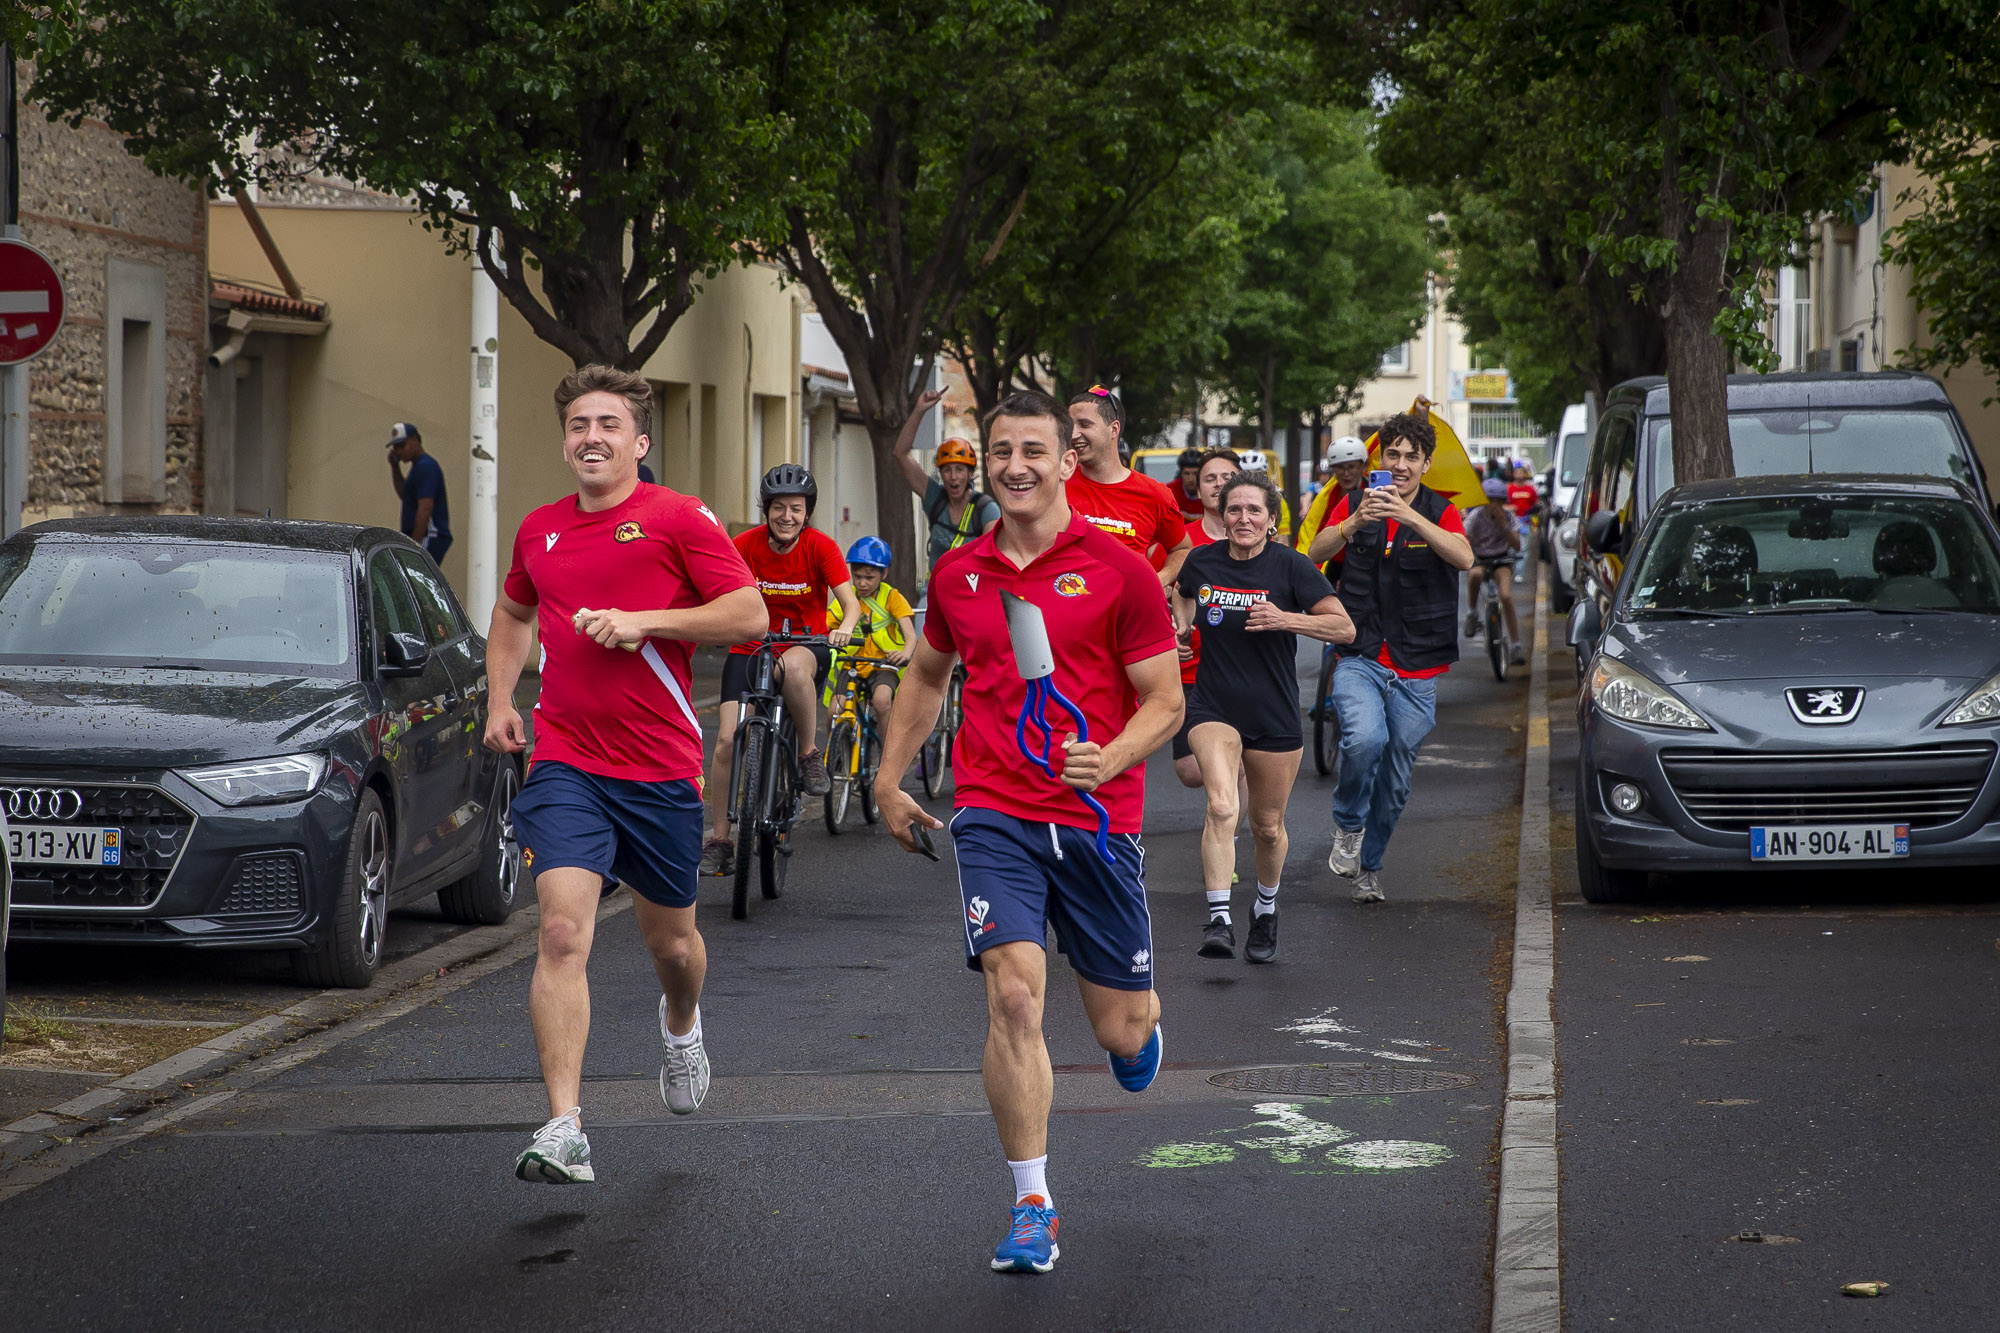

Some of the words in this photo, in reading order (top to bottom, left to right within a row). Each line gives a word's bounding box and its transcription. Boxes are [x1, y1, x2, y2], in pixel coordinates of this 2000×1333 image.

[1769, 829, 1891, 856] AN-904-AL
[1895, 841, 1908, 852] 66
[103, 850, 118, 863] 66
